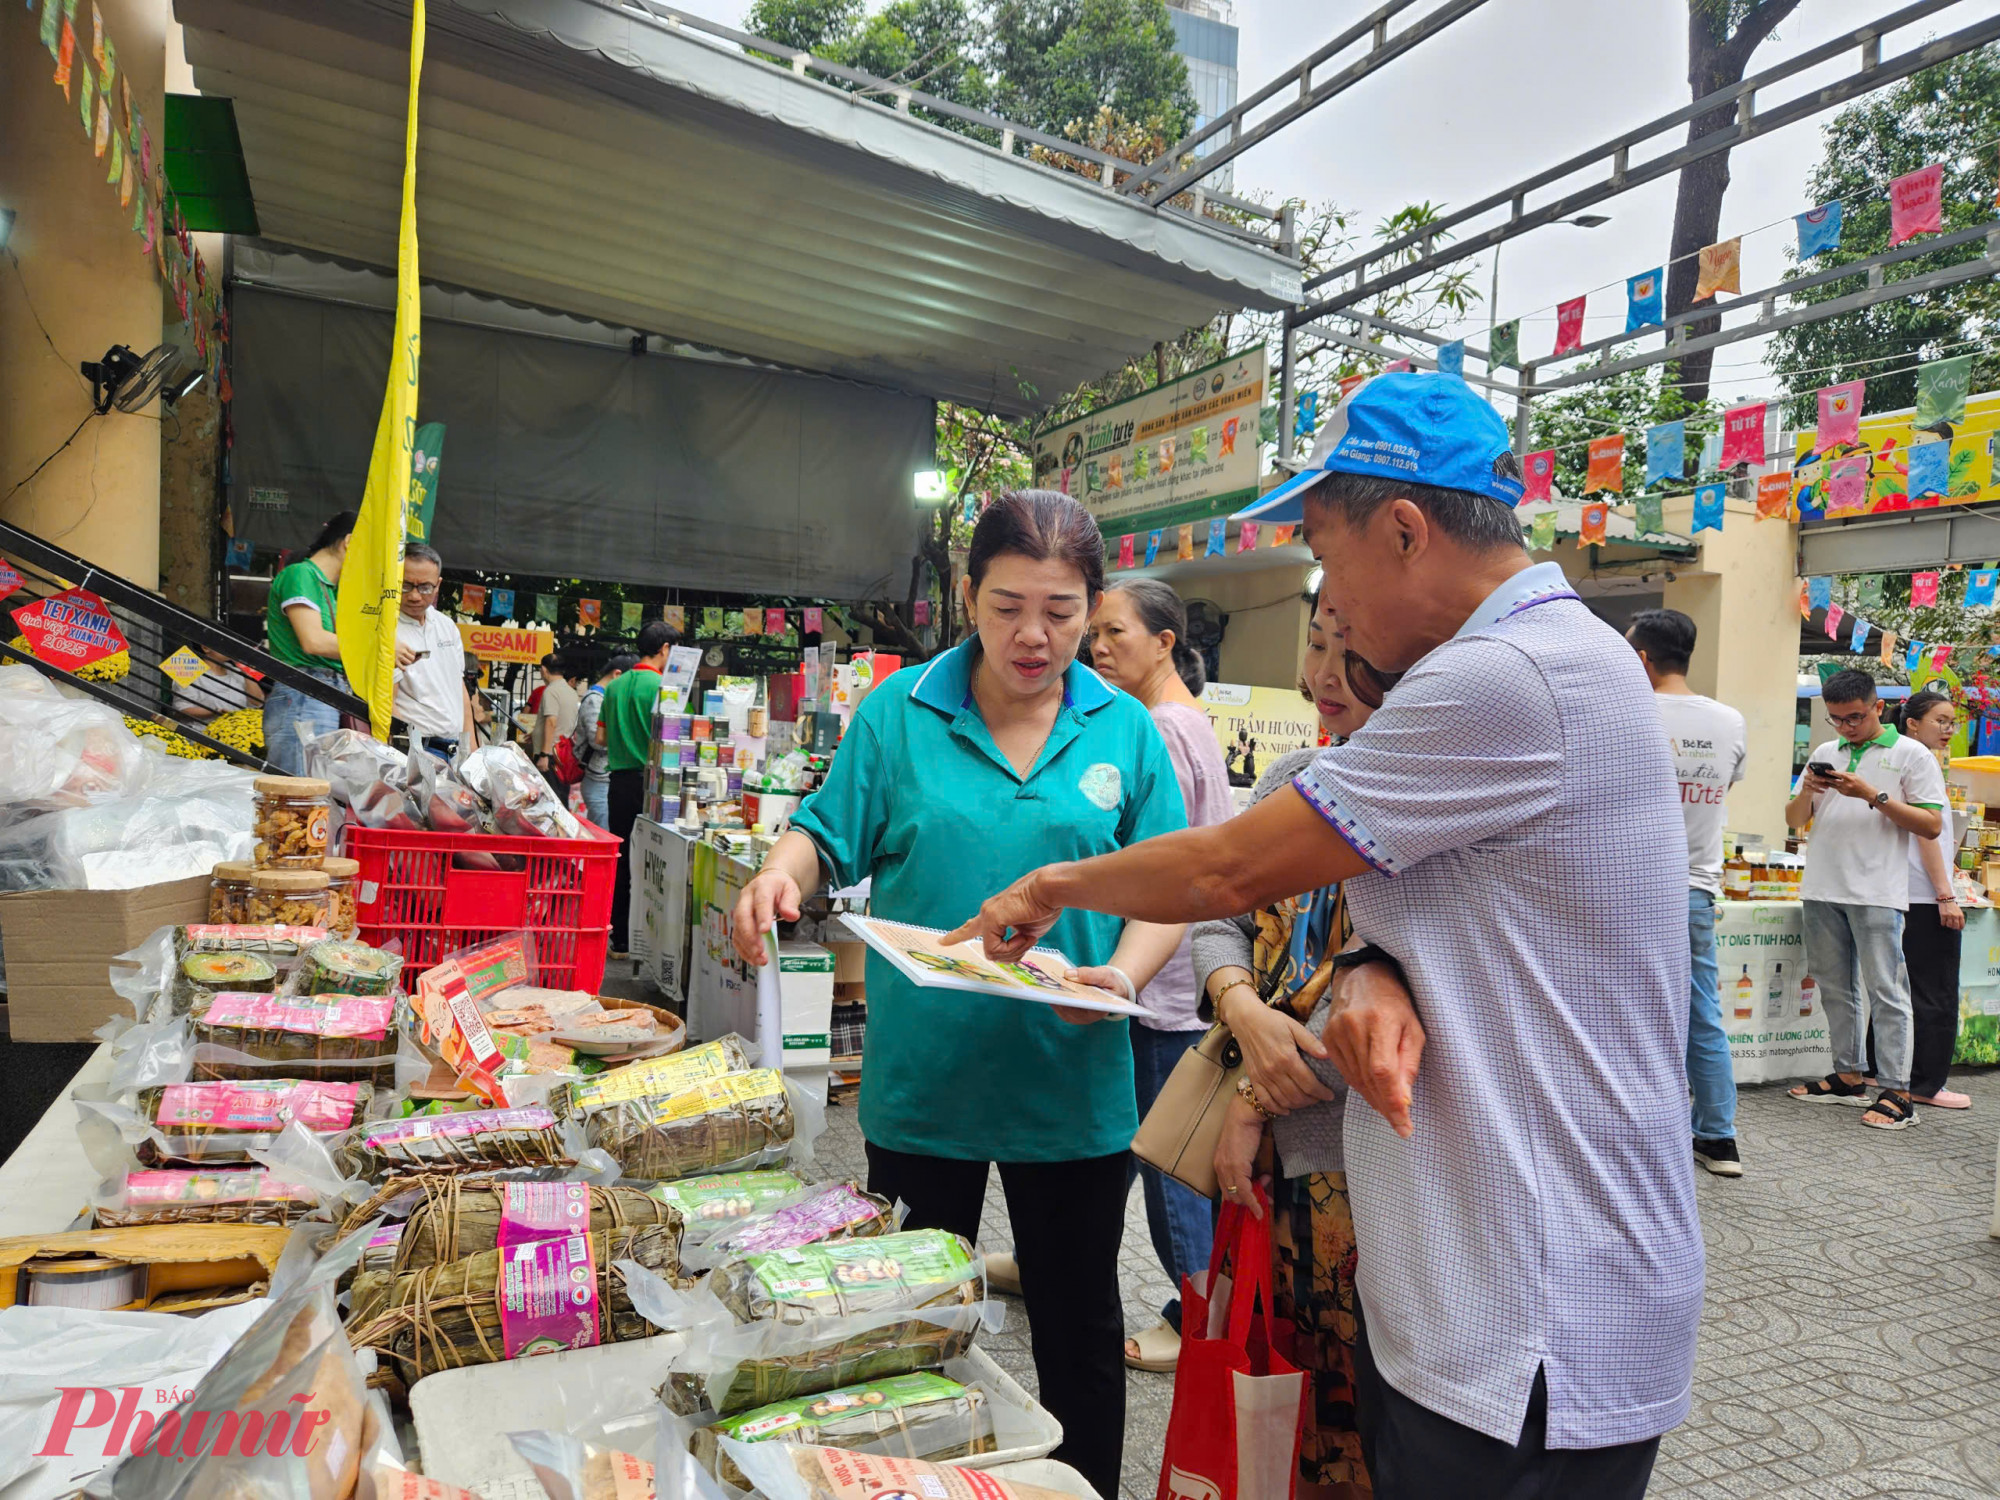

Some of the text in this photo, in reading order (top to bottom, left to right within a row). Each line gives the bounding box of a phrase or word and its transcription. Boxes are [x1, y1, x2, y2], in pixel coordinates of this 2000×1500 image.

[1896, 174, 1936, 198] Minh
[1923, 368, 1966, 404] Xanh
[1730, 414, 1758, 432] TỬ TẾ
[1338, 448, 1419, 472] An Giang: 0907.112.919
[20, 611, 43, 629] Quà
[43, 616, 69, 637] Việt
[68, 625, 93, 645] XUÂN
[70, 607, 113, 635] XANH
[41, 633, 88, 658] 2025
[1268, 720, 1313, 738] HƯƠNG
[1729, 934, 1751, 946] ONG
[1754, 934, 1778, 946] TINH
[1779, 934, 1802, 946] HOA
